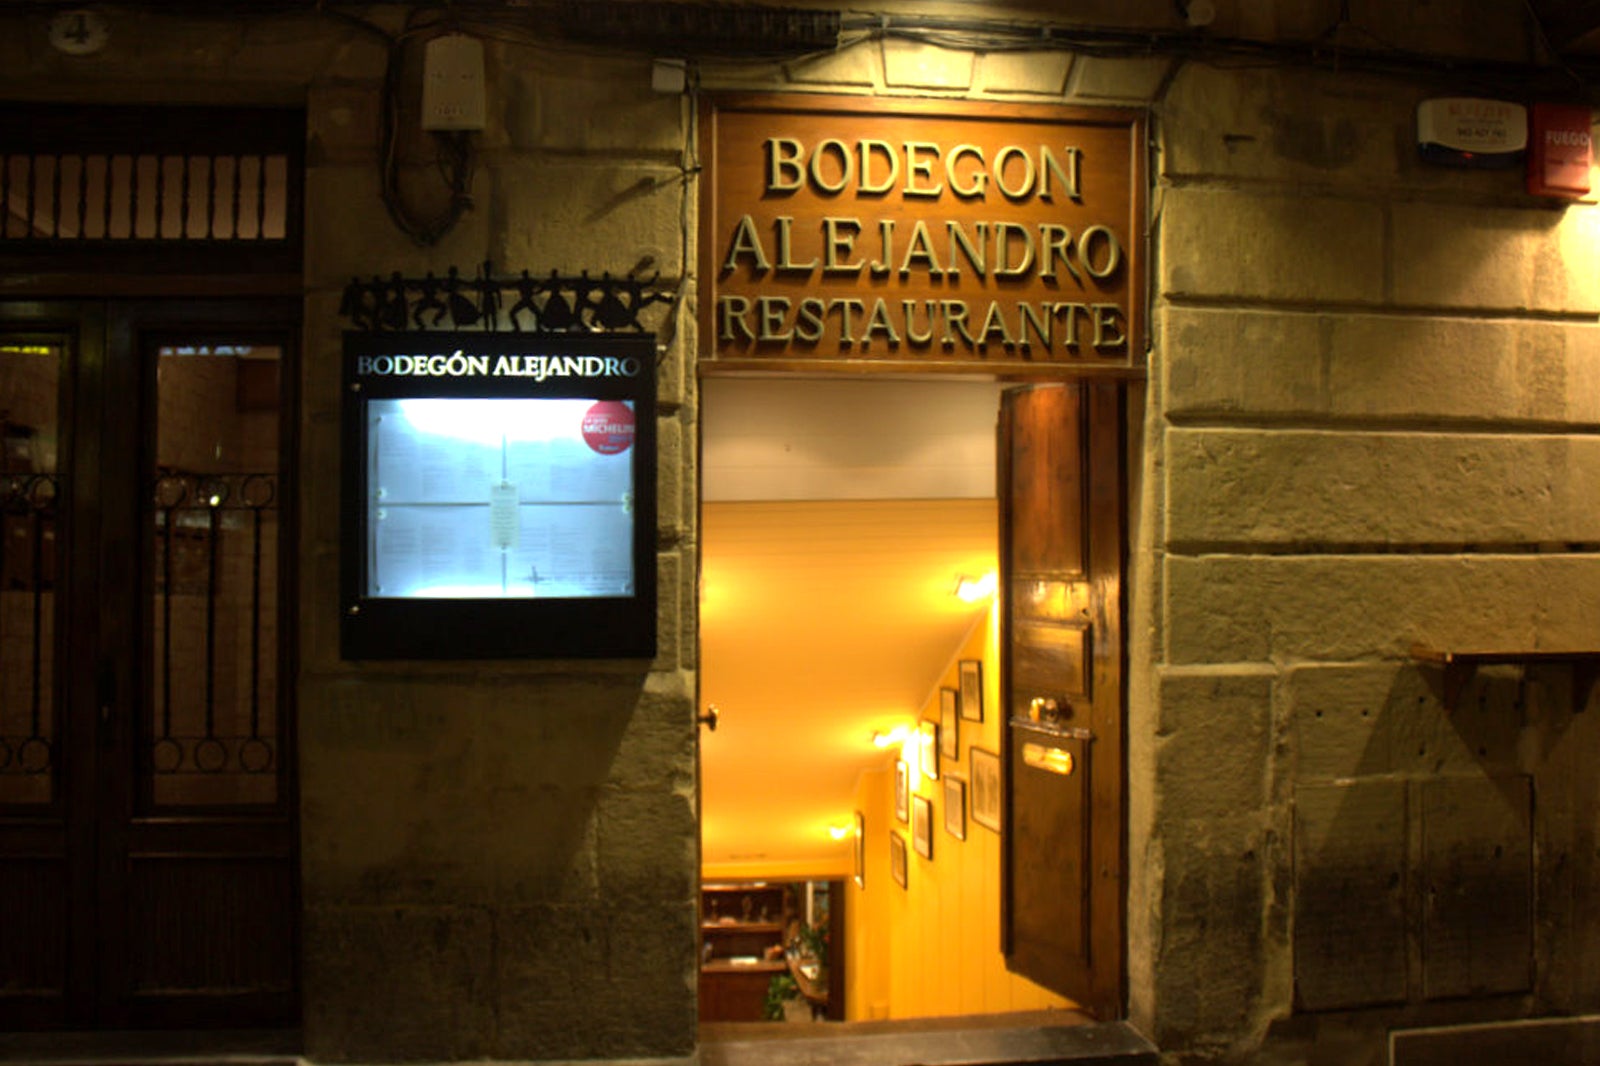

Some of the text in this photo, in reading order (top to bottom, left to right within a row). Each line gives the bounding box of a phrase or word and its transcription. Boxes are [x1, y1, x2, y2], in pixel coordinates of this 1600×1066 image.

[64, 14, 90, 44] 4
[1545, 131, 1589, 146] FUEGO
[767, 136, 1081, 199] BODEGON
[723, 213, 1121, 278] ALEJANDRO
[719, 295, 1126, 347] RESTAURANTE
[358, 350, 640, 382] BODEGÓN ALEJANDRO
